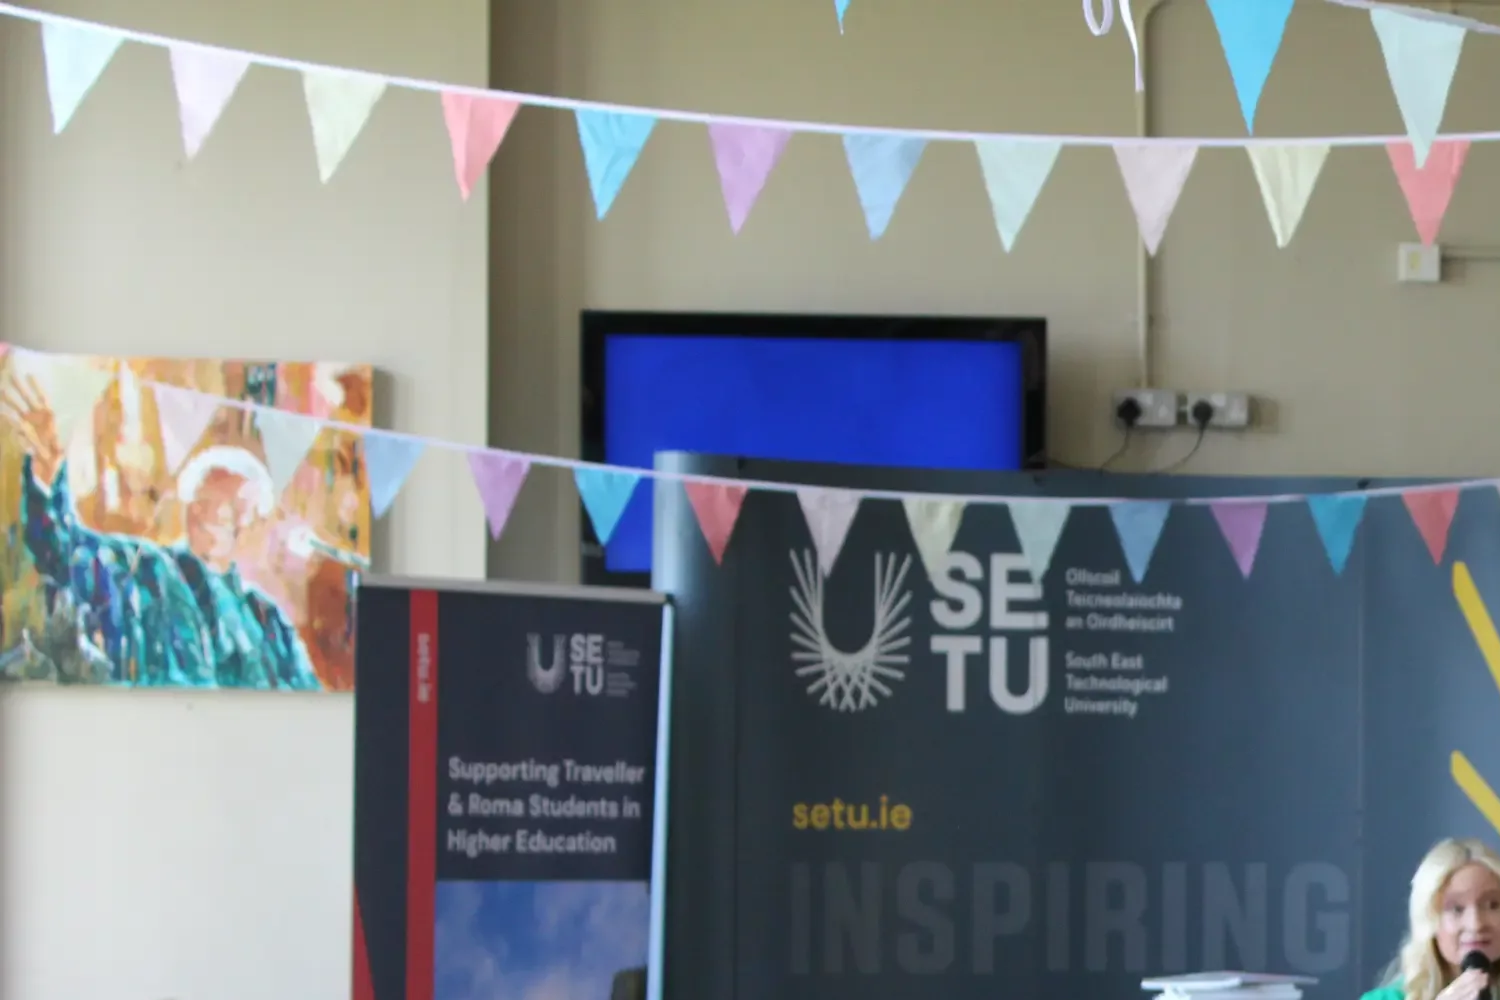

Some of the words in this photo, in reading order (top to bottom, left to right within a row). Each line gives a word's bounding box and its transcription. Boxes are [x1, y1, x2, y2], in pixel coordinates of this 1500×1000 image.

[930, 551, 1049, 629] SE
[570, 633, 605, 663] SE
[1065, 651, 1108, 669] South
[1111, 652, 1143, 669] East
[570, 664, 605, 695] TU
[930, 635, 1049, 714] TU
[1065, 674, 1169, 695] Technological
[1064, 697, 1138, 718] University
[448, 756, 559, 787] Supporting
[564, 759, 645, 784] Traveller
[447, 793, 463, 815] &
[468, 794, 524, 816] Roma
[529, 796, 619, 818] Students
[622, 796, 641, 818] in
[792, 795, 912, 830] setu.ie
[447, 829, 512, 857] Higher
[516, 830, 616, 854] Education
[789, 860, 1351, 976] INSPIRING
